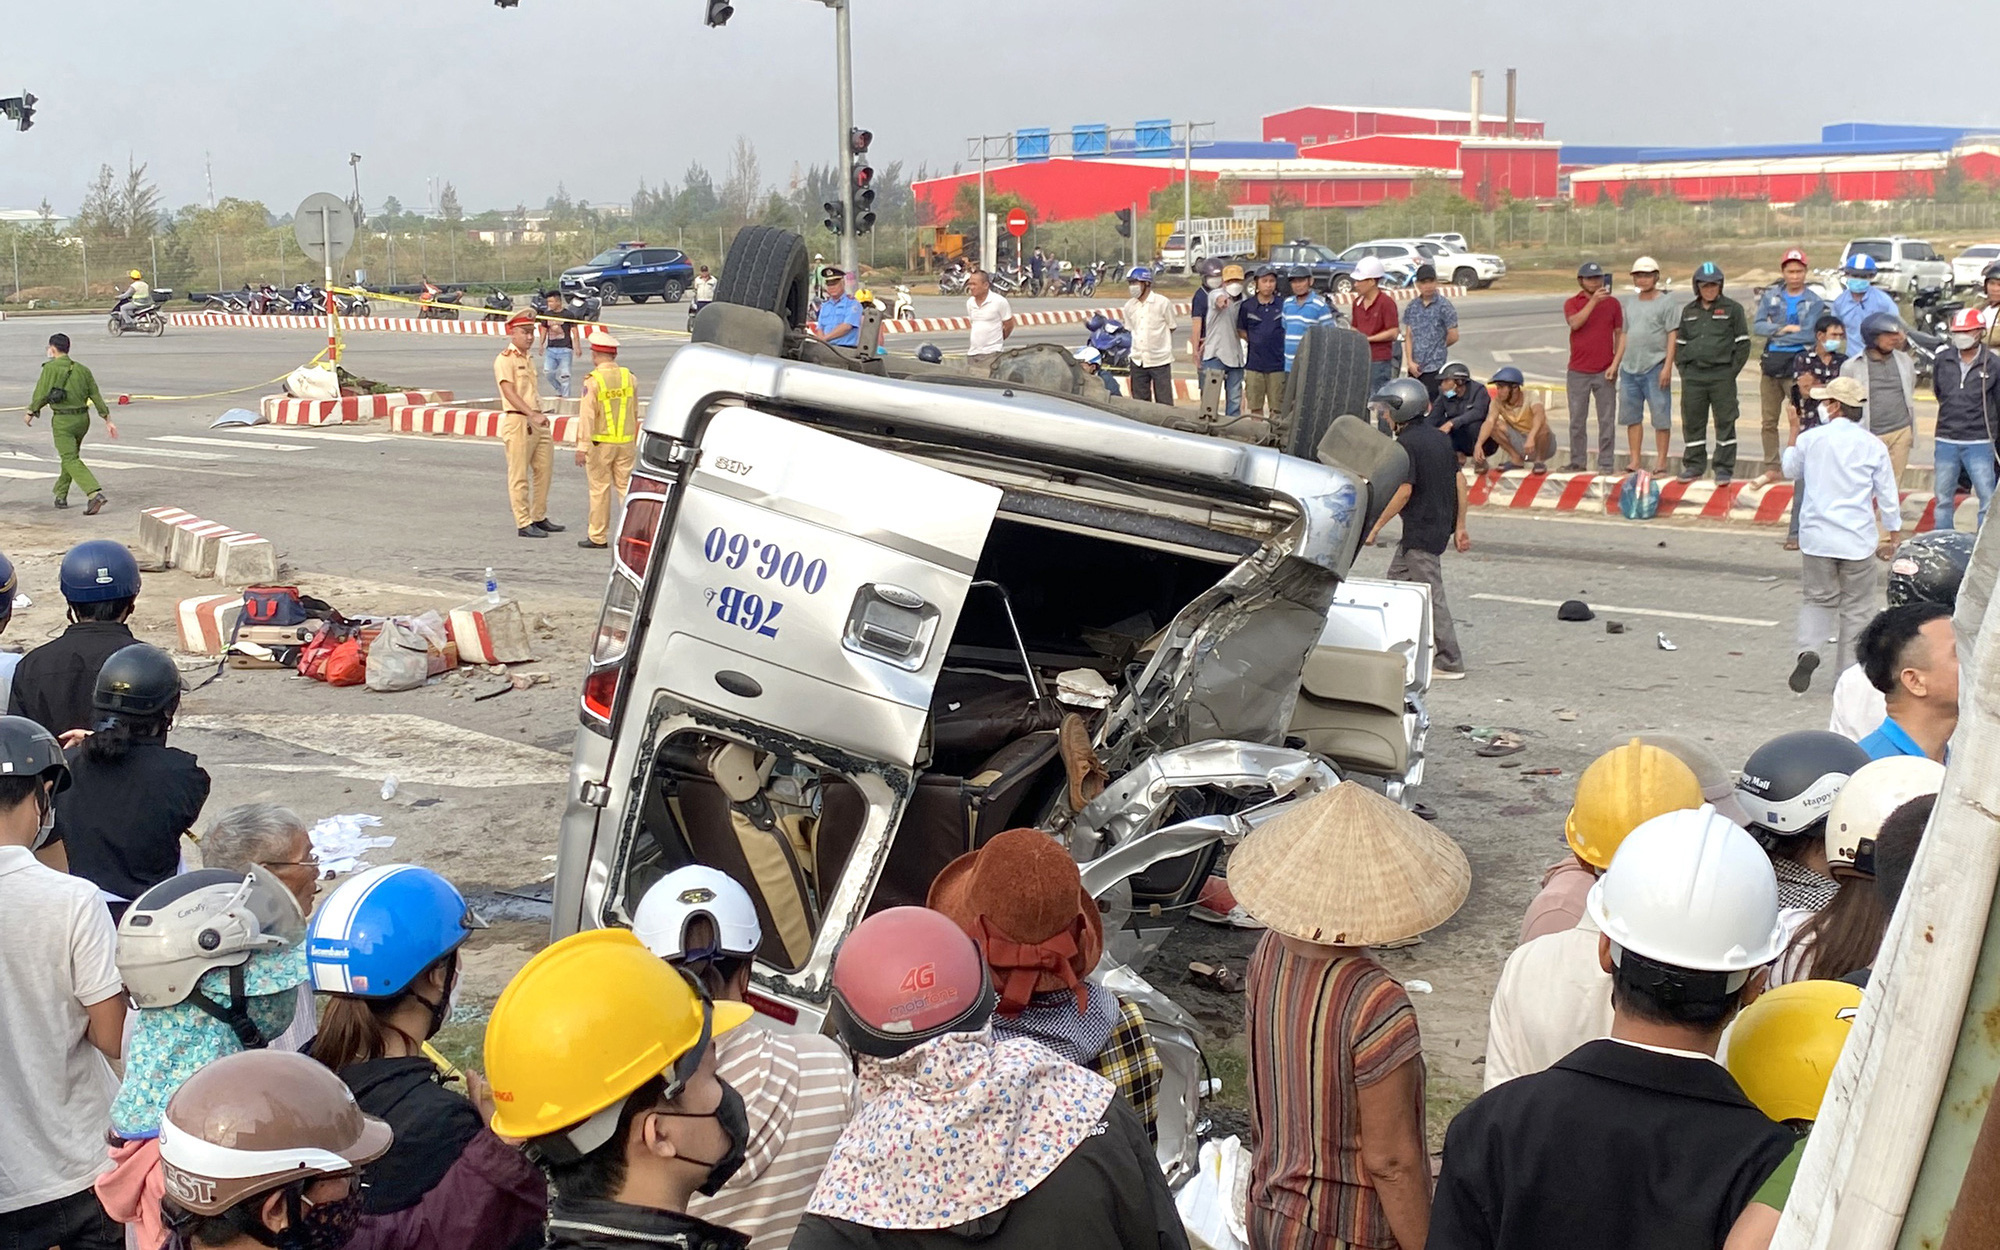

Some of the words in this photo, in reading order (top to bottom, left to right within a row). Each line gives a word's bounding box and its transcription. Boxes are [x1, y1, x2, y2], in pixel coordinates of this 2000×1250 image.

[605, 389, 626, 399] CSGT
[715, 456, 753, 475] ABS
[704, 526, 827, 594] 006.60
[716, 586, 784, 640] 76B
[899, 962, 935, 993] 4G
